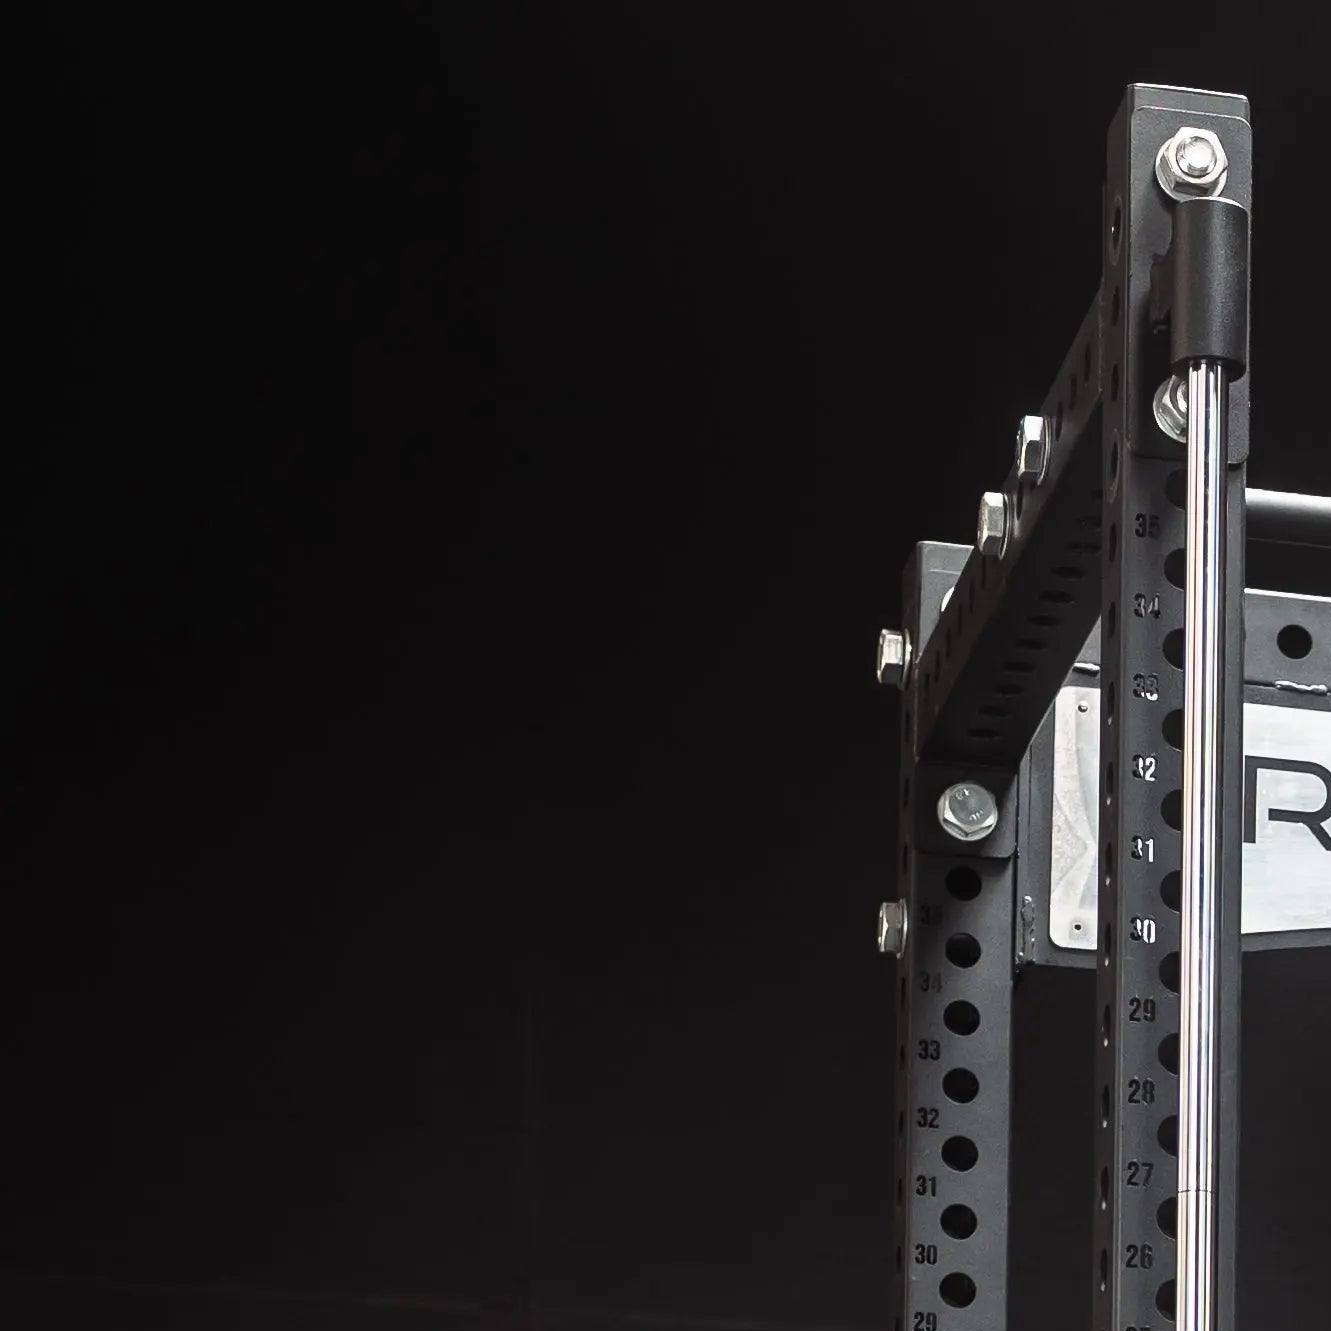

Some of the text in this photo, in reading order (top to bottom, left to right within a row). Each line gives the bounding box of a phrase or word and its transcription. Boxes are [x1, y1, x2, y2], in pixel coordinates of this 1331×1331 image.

[1134, 594, 1161, 618] 34
[1132, 756, 1157, 782] 32
[1131, 836, 1154, 862] 31
[1130, 917, 1156, 943] 30
[1129, 998, 1156, 1022] 29
[919, 1040, 940, 1060] 33
[1128, 1080, 1154, 1104] 28
[918, 1108, 939, 1128] 32
[916, 1176, 937, 1196] 31
[1127, 1163, 1153, 1186] 27
[915, 1244, 937, 1265] 30
[1126, 1245, 1152, 1269] 26
